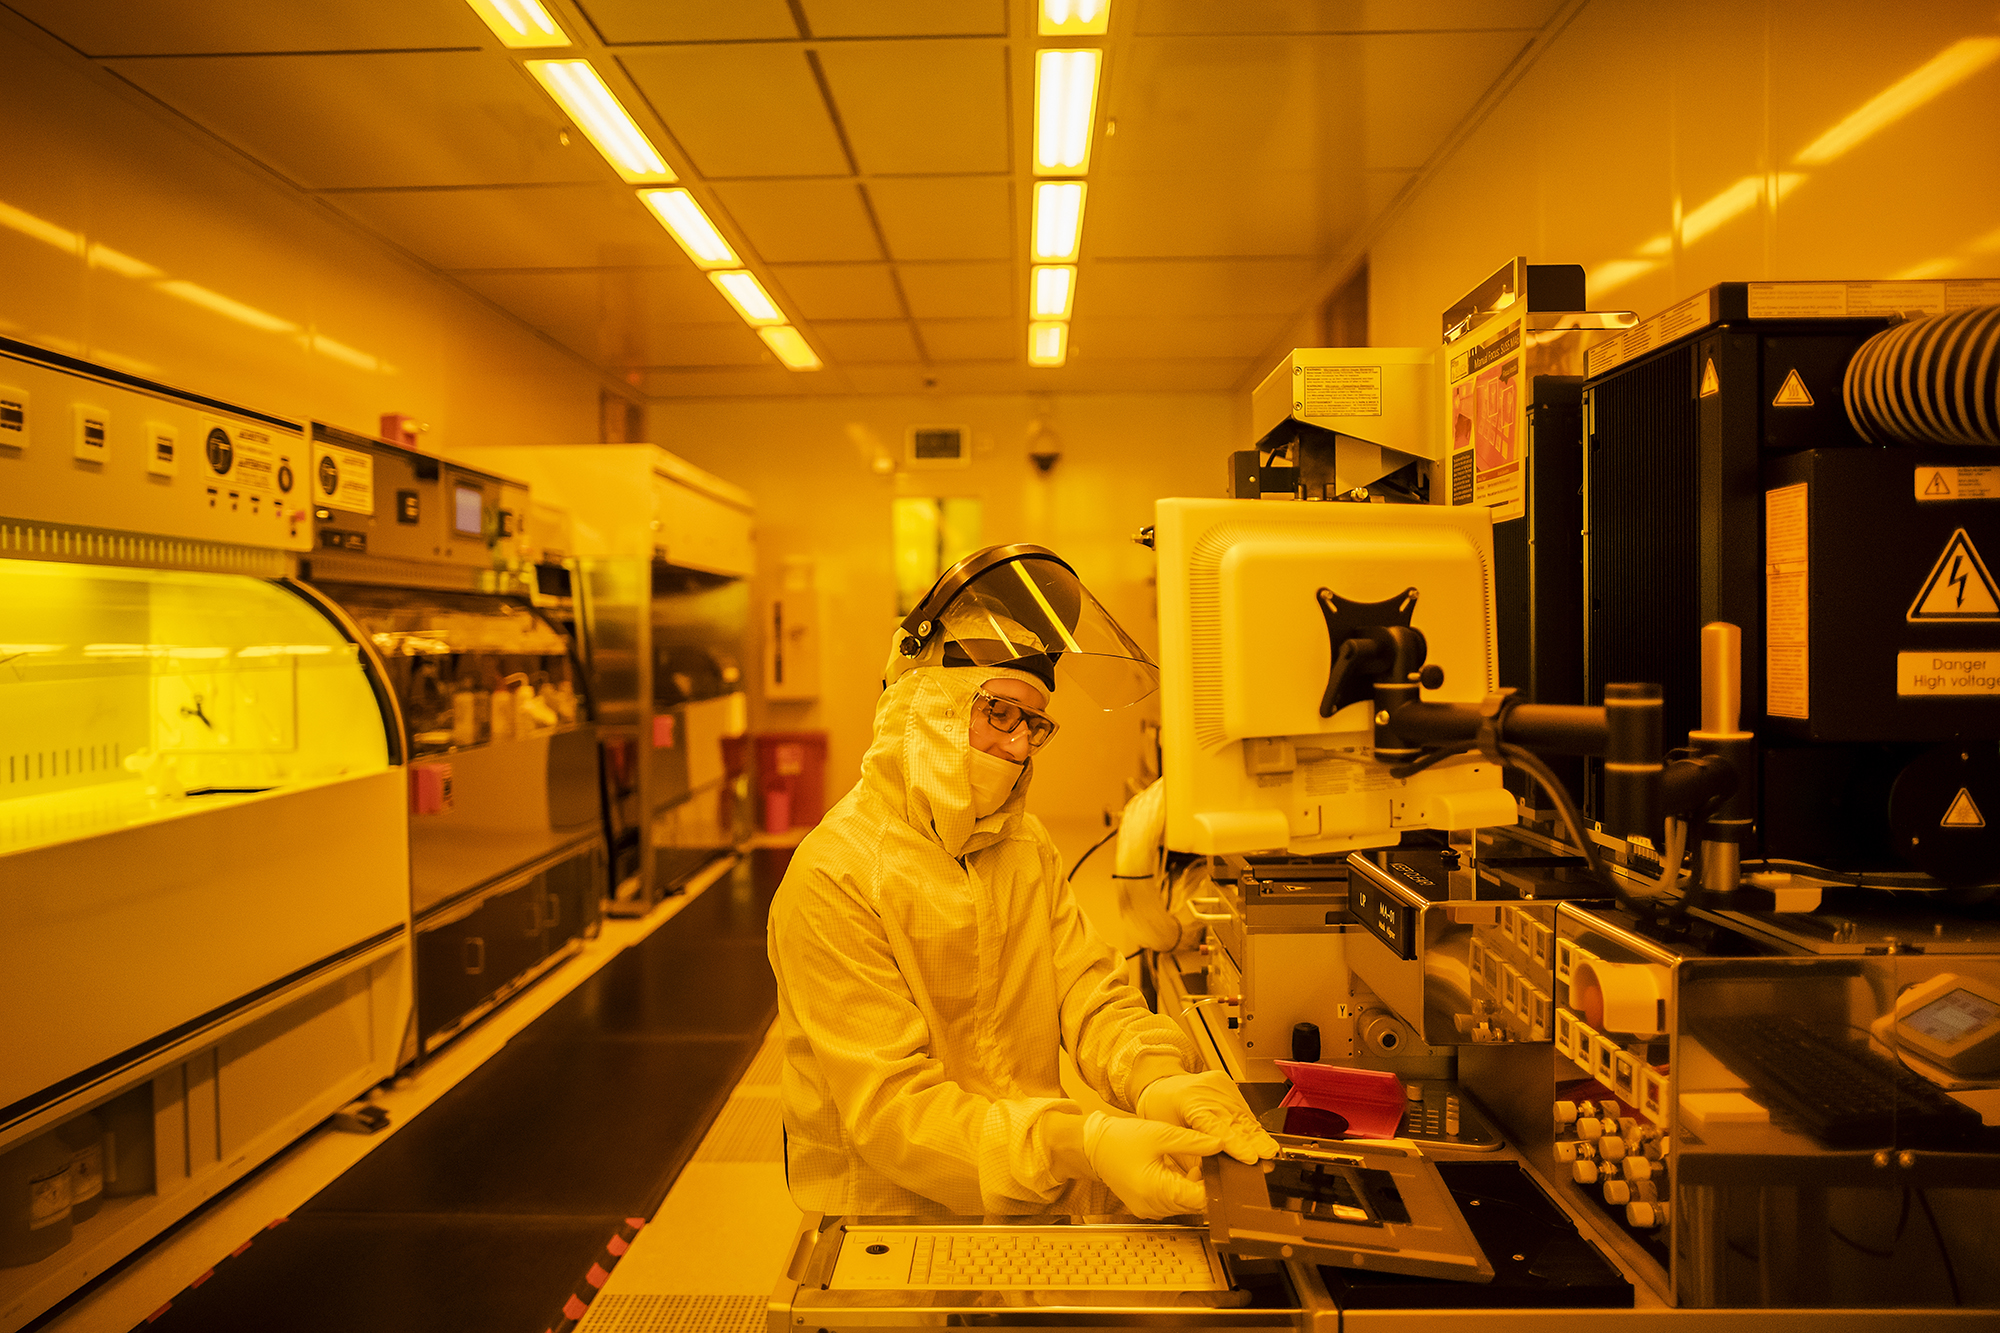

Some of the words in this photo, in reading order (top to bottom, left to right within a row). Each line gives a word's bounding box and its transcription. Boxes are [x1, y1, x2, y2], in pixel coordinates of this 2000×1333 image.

[1474, 352, 1488, 369] Manual
[1932, 658, 1986, 673] Danger
[1913, 675, 1946, 690] High
[1340, 1005, 1345, 1017] Y
